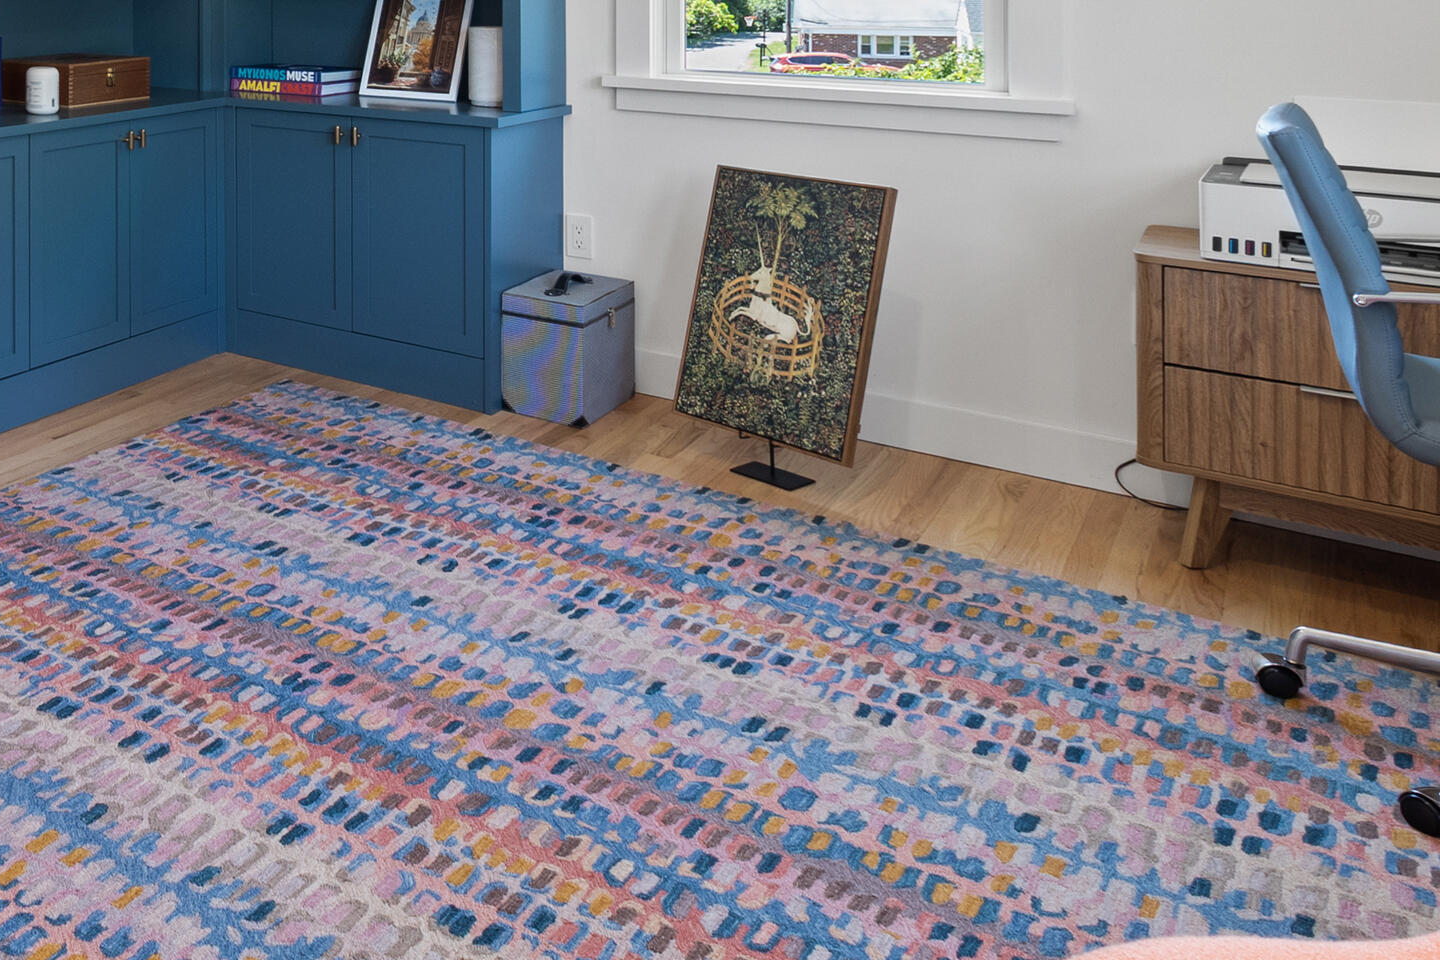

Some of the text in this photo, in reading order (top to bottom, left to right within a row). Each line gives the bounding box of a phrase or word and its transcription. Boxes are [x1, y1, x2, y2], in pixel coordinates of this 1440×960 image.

[238, 67, 315, 82] MYKONOS MUSE
[239, 80, 314, 95] AMALFI COAST
